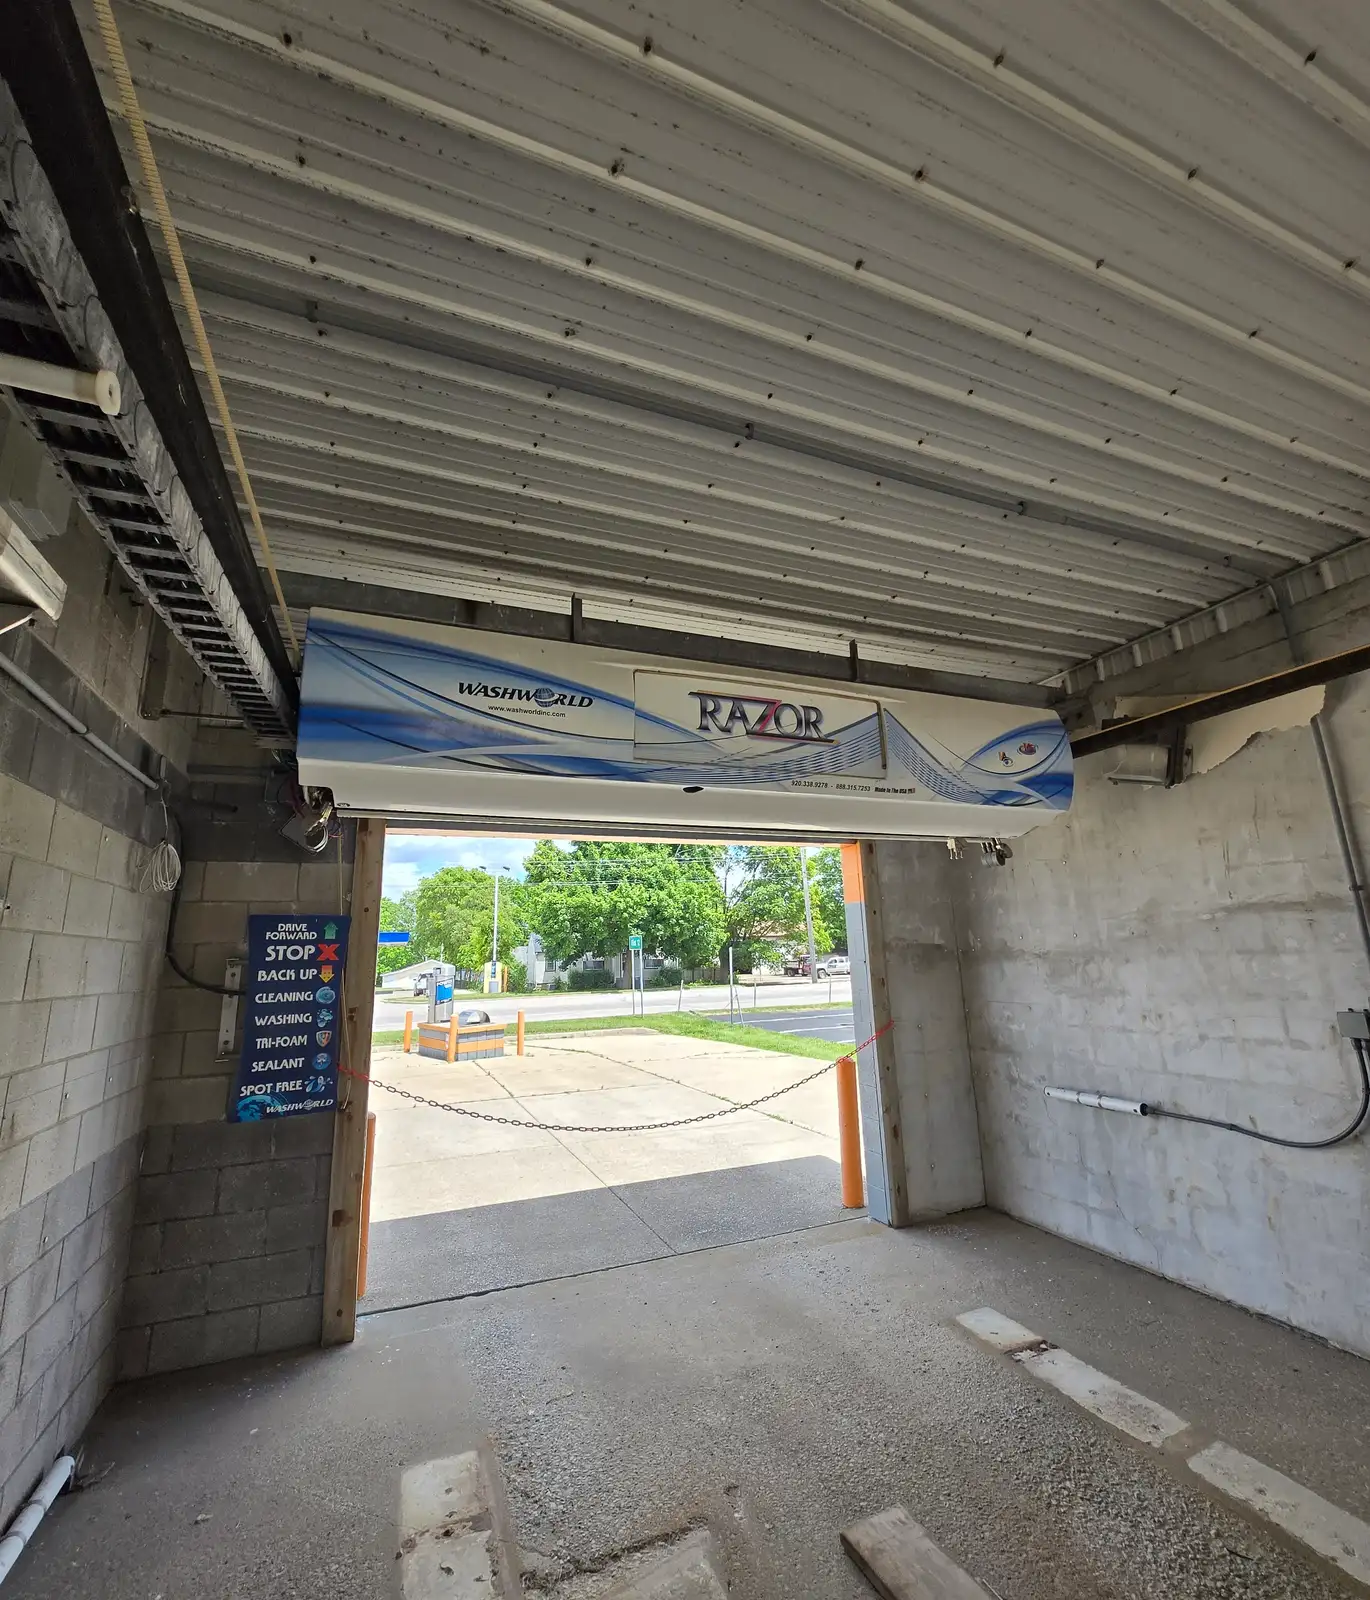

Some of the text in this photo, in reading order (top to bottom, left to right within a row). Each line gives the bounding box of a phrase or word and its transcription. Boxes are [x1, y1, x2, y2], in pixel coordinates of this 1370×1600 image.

[488, 705, 566, 718] www.washworldinc.com
[687, 689, 841, 745] RAZOR
[791, 780, 828, 789] 920.338.9278
[835, 783, 871, 792] 888.315.7253
[278, 923, 308, 932] DRIVE
[265, 931, 318, 940] FORWARD
[265, 945, 316, 961] STOP
[257, 968, 318, 982] BACK UP
[255, 991, 314, 1004] CLEANING
[255, 1013, 313, 1026] WASHING
[256, 1035, 308, 1049] TRI-FOAM
[251, 1058, 305, 1073] SEALANT
[240, 1080, 303, 1097] SPOT FREE
